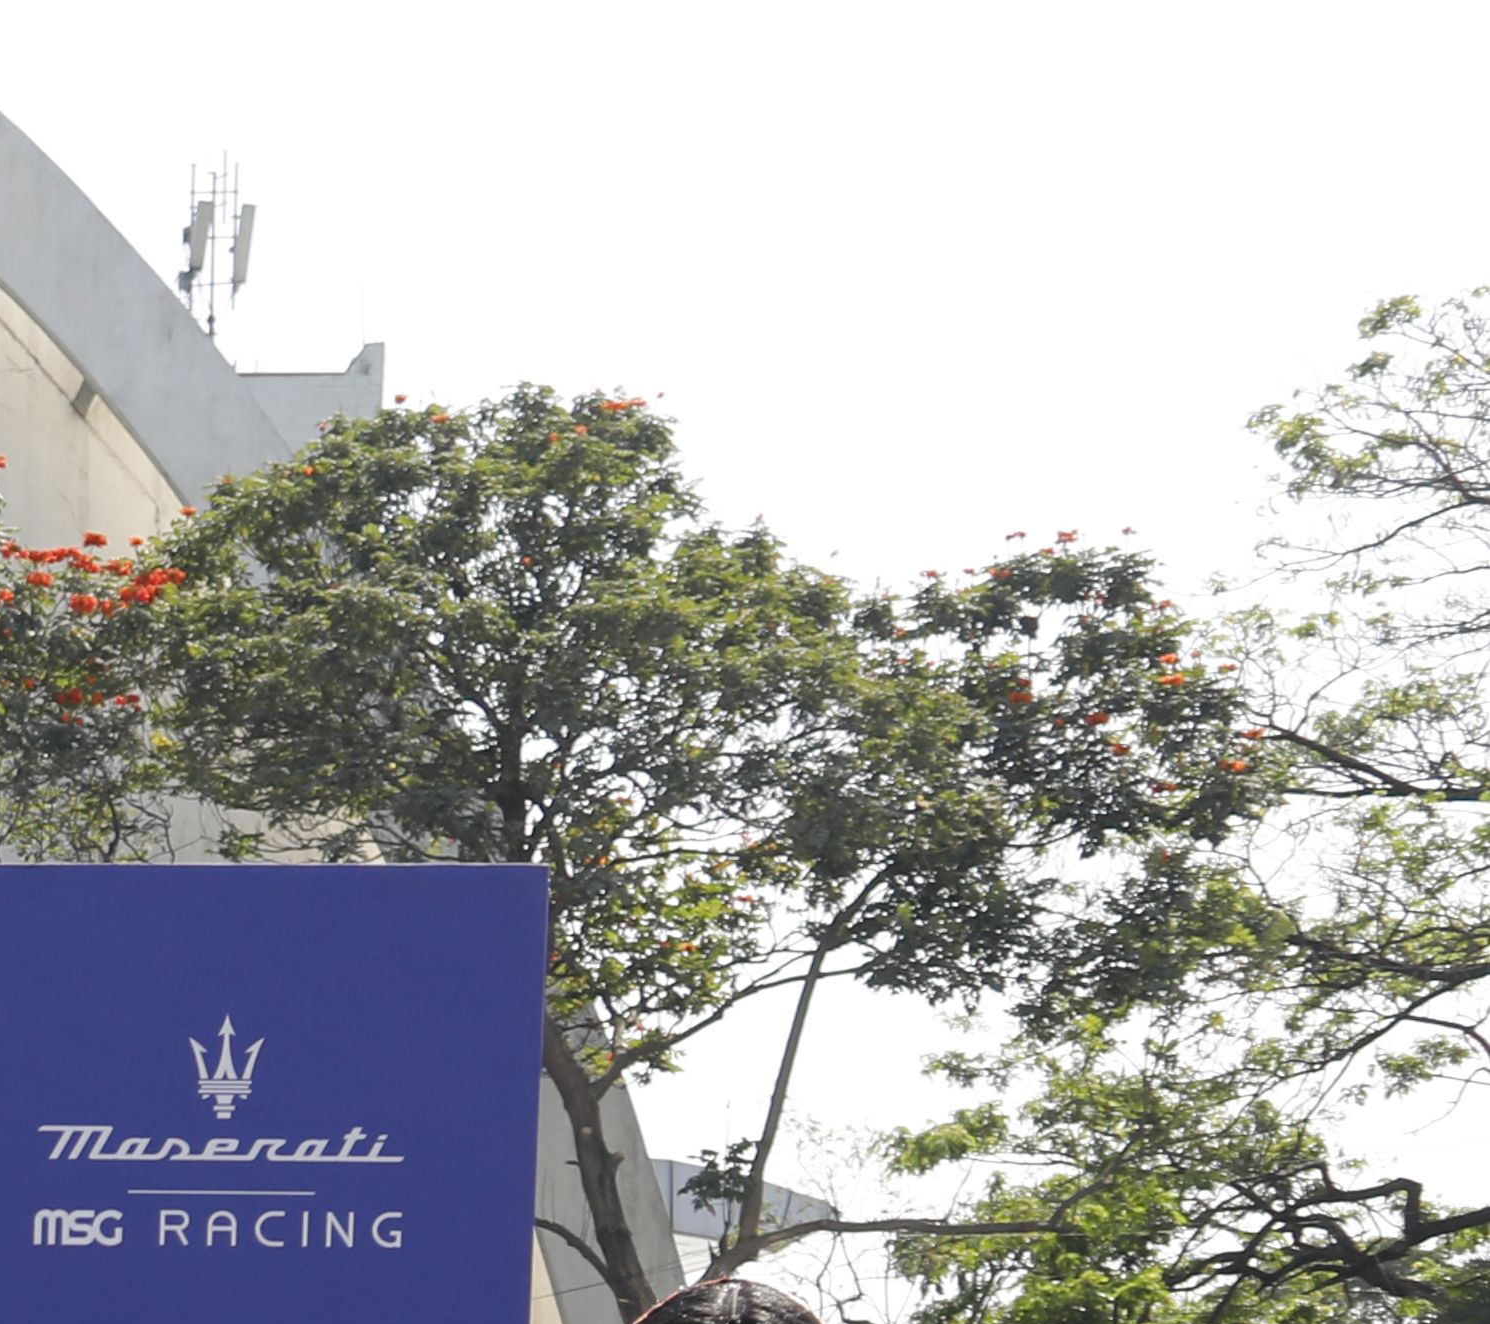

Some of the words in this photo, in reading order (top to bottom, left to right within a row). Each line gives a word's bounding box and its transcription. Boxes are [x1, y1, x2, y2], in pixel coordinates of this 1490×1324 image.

[37, 1125, 405, 1163] Maserati
[33, 1209, 124, 1246] MSG
[159, 1209, 404, 1249] RACING
